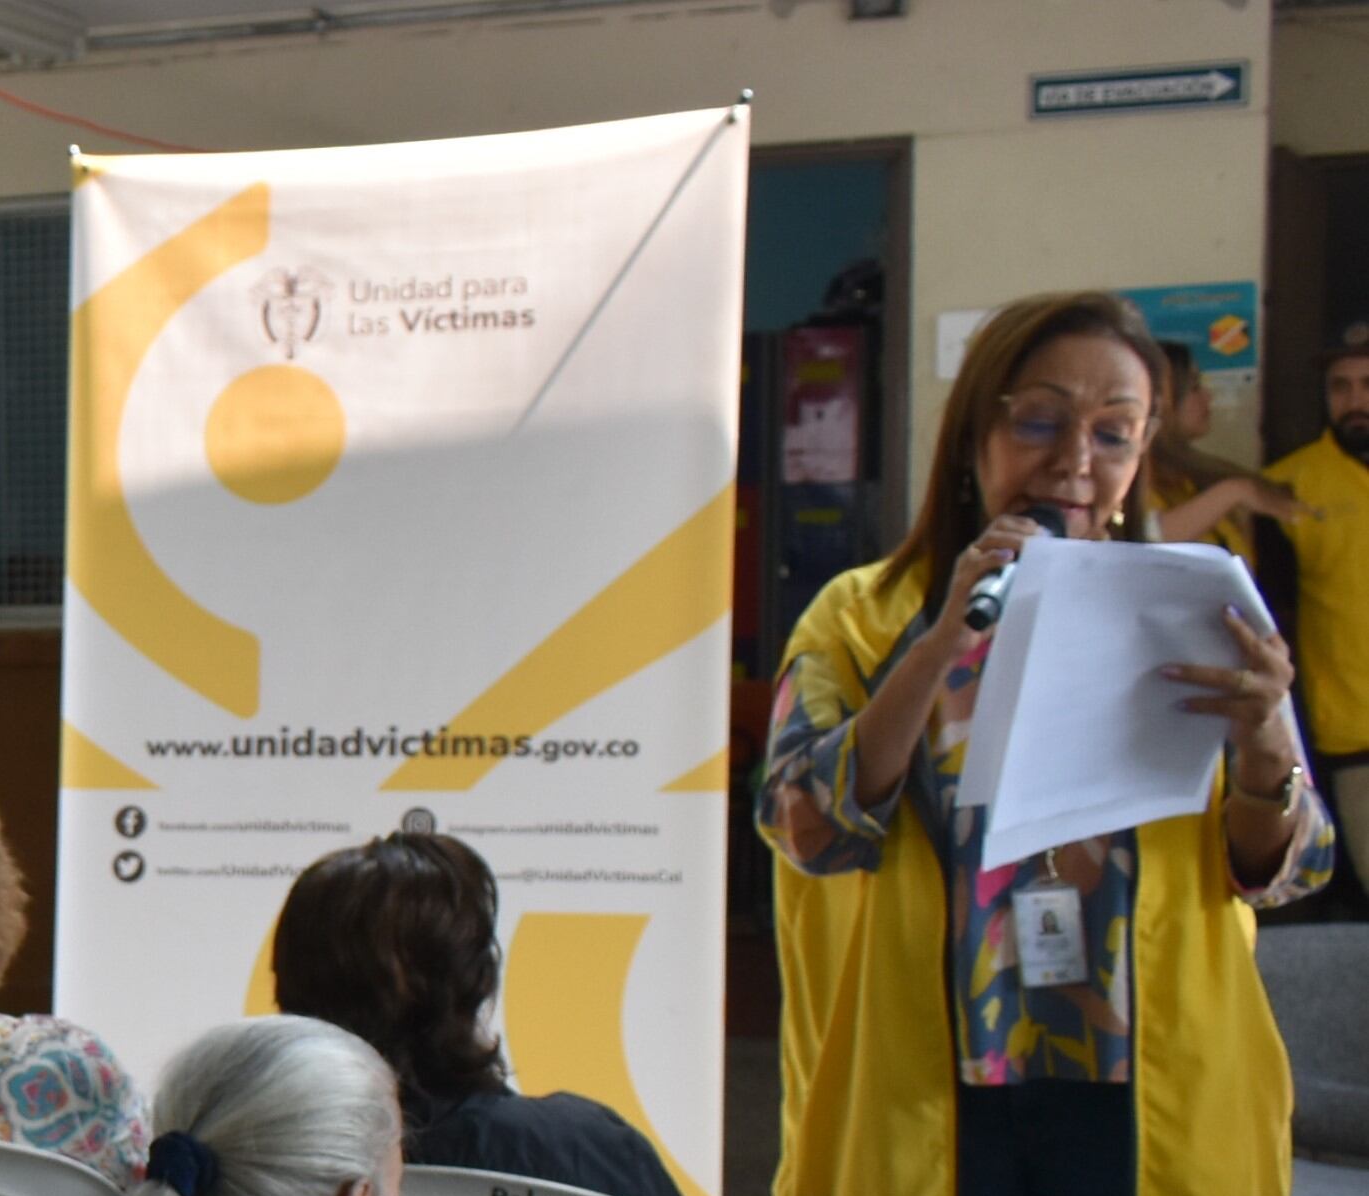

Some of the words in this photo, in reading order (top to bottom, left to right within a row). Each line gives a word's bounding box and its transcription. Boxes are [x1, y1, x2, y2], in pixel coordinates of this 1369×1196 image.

[349, 274, 453, 303] Unidad
[463, 275, 528, 302] para
[349, 311, 390, 336] las
[399, 304, 536, 333] Víctimas
[145, 726, 640, 763] www.unidadvictimas.gov.co
